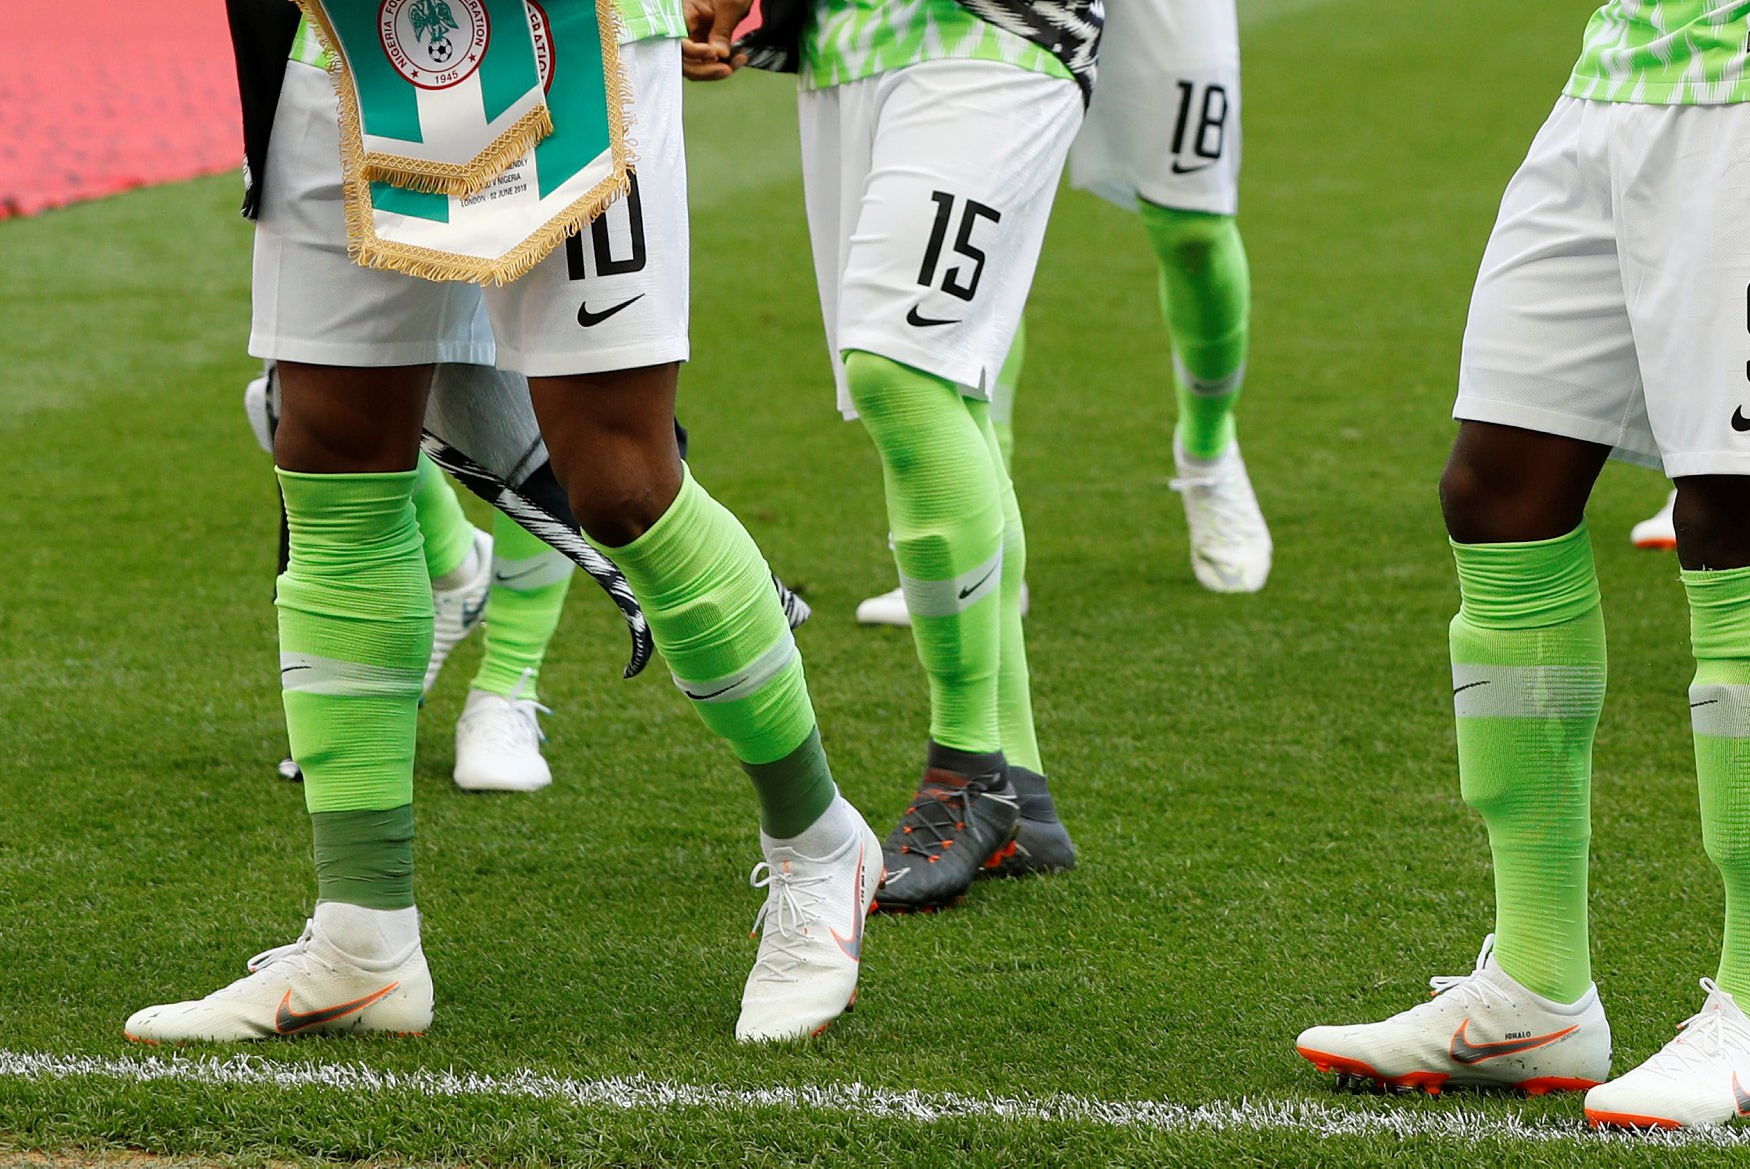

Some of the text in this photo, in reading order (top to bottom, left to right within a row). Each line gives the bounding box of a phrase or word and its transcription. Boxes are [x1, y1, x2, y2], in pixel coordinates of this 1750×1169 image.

[383, 20, 408, 69] NIGERIA
[434, 69, 460, 85] 1945
[1171, 79, 1228, 159] 18
[460, 195, 486, 207] LONDON
[498, 188, 514, 198] JUNE
[514, 184, 527, 194] 2018
[498, 173, 521, 185] NIGERIA
[917, 190, 1002, 302] 15
